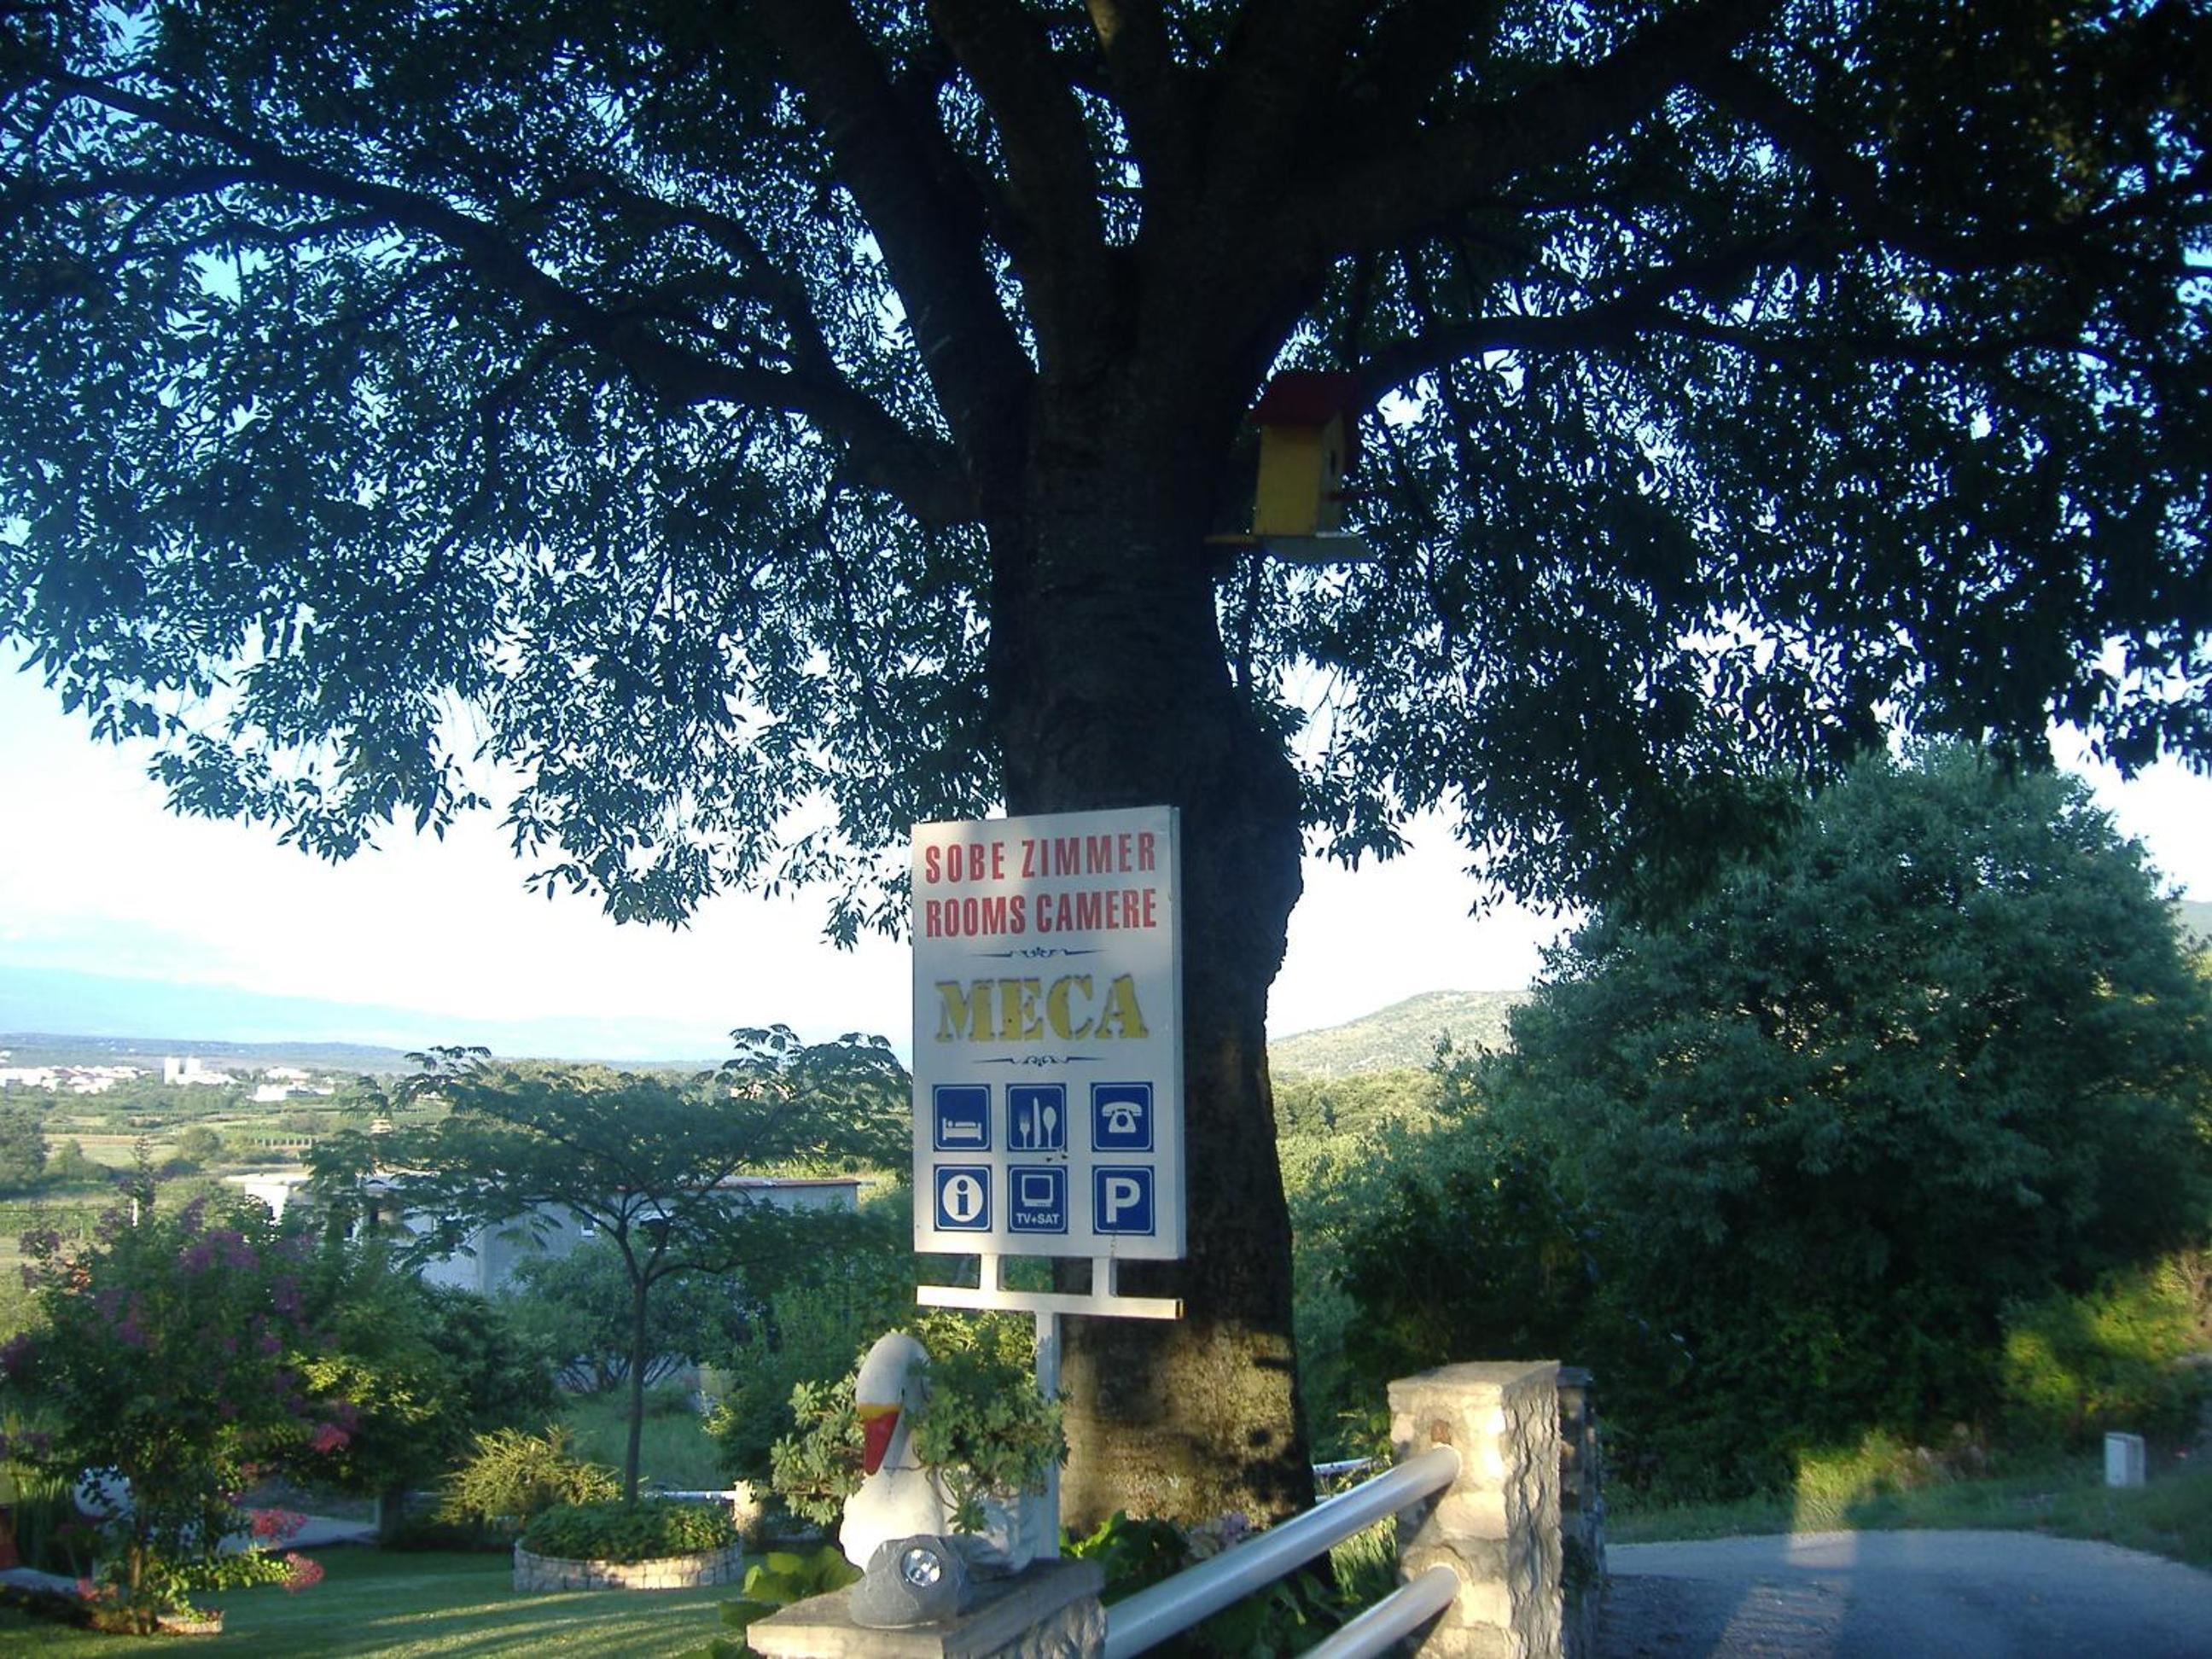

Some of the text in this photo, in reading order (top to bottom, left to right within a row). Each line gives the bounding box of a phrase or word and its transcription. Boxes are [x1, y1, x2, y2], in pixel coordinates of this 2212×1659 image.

[925, 832, 1155, 883] SOBE ZIMMER
[926, 888, 1157, 938] ROOMS CAMERE
[934, 972, 1149, 1043] MECA
[1105, 1177, 1141, 1224] P
